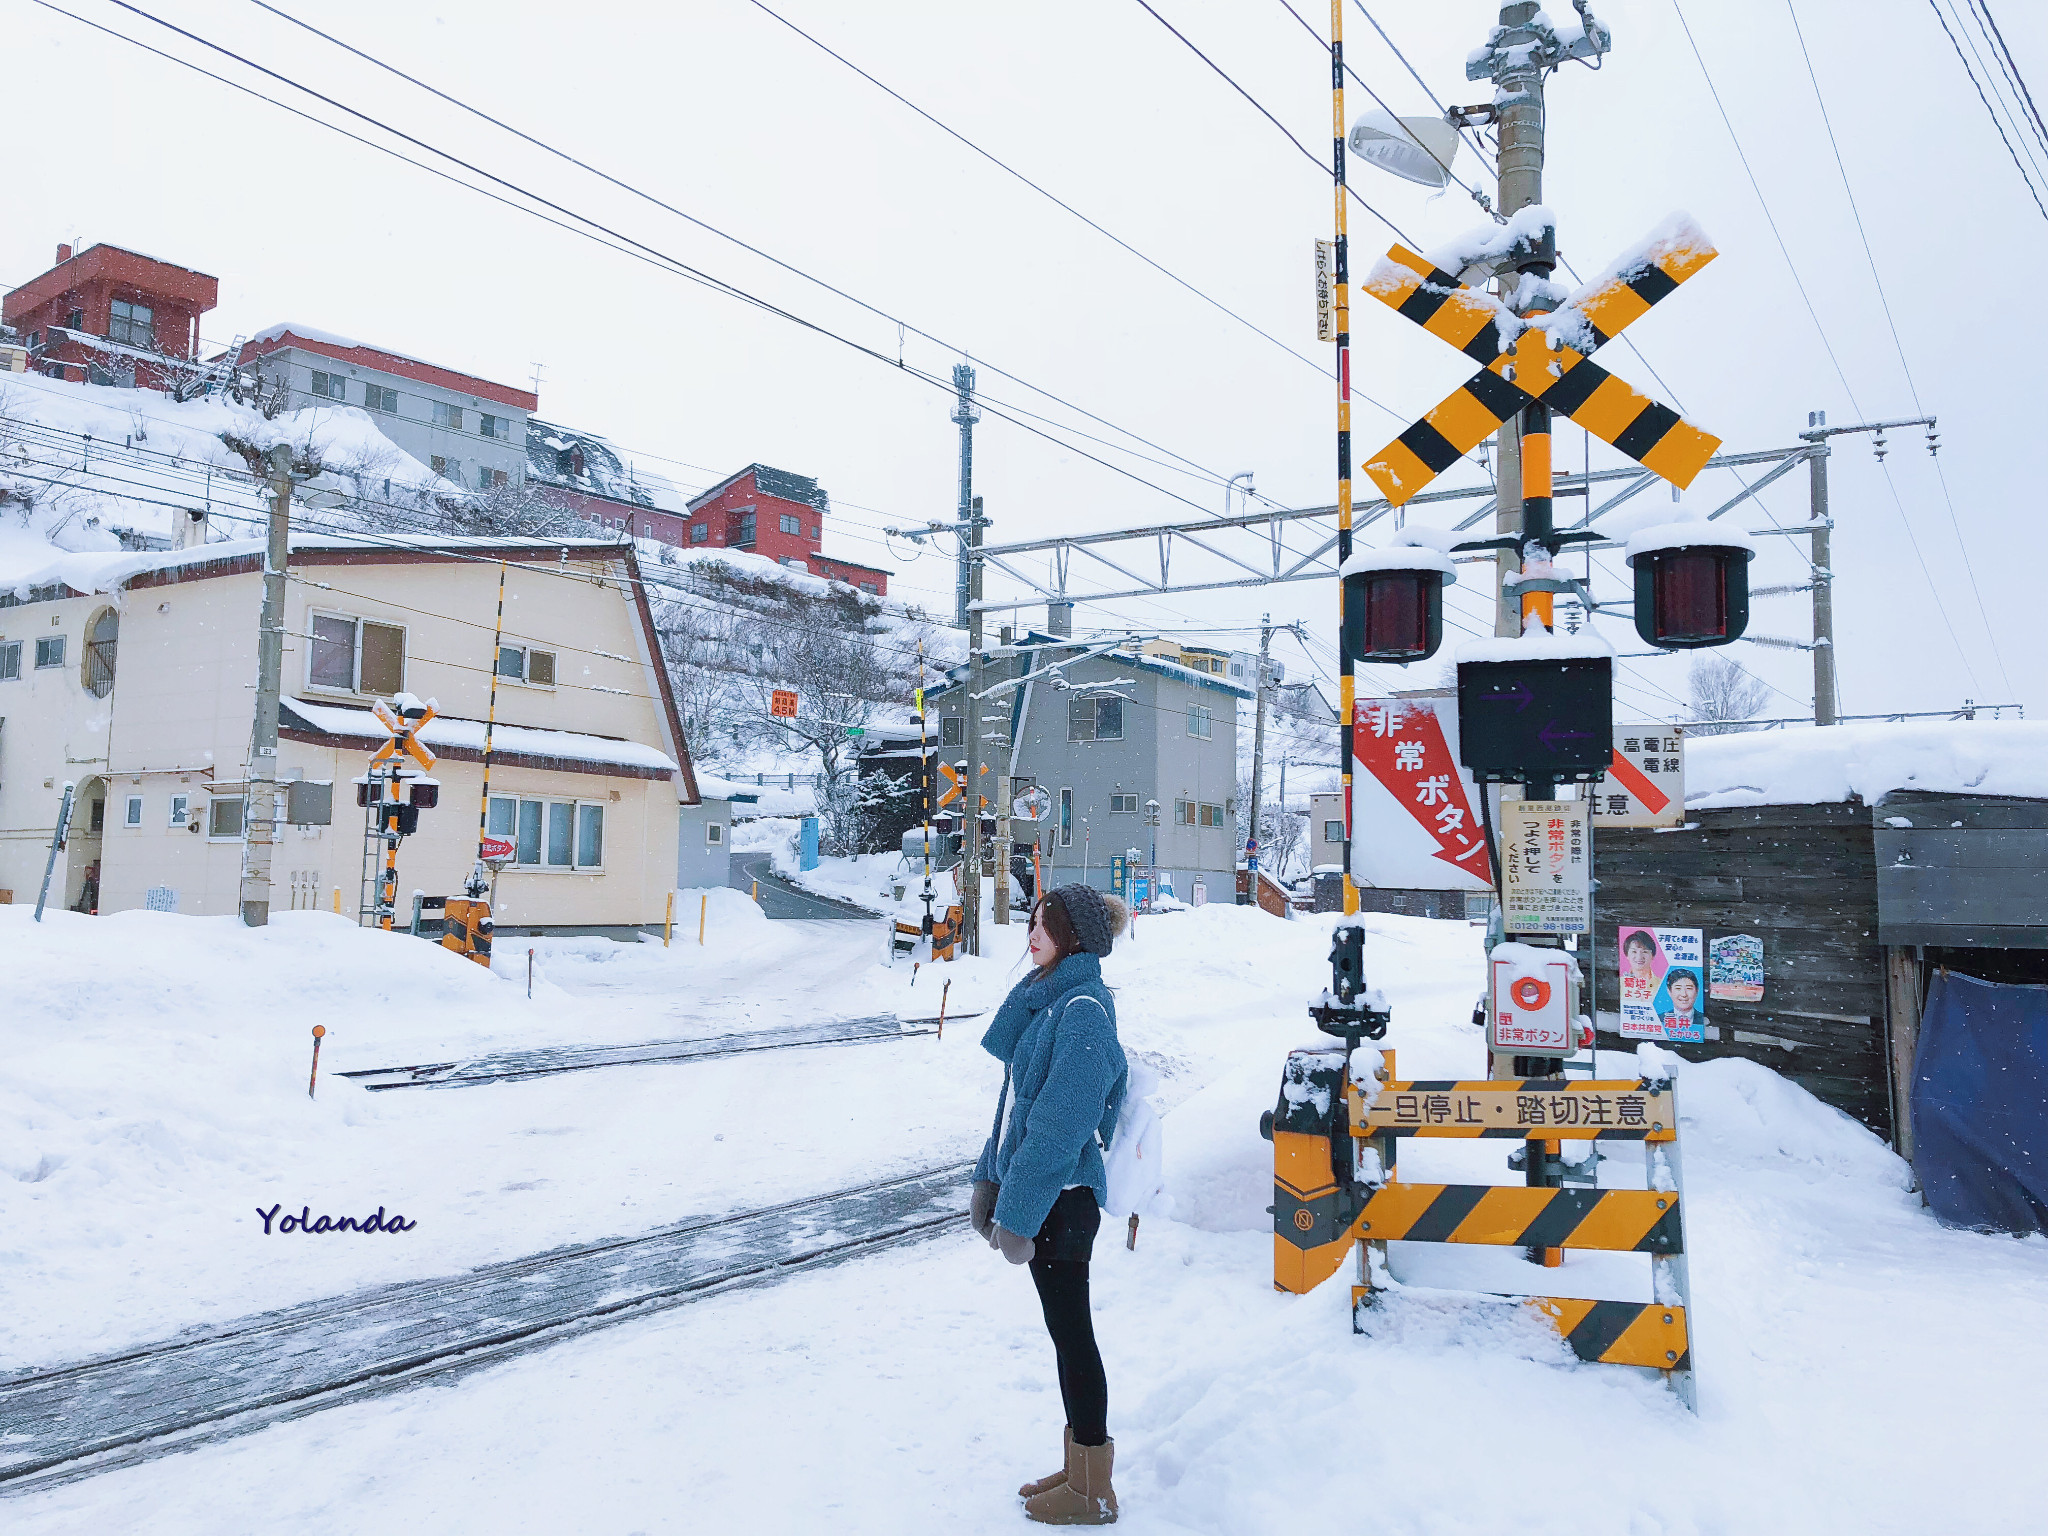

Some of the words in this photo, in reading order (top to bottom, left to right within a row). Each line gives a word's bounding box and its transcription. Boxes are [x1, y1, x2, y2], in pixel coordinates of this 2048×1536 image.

[1623, 737, 1680, 753] 高電圧
[1643, 757, 1680, 773] 電線
[1371, 707, 1485, 861] 非常ボタン
[1523, 820, 1541, 874] つよく押して
[1547, 818, 1565, 884] 非常ボタンを
[1570, 819, 1582, 864] 非常の際は
[1508, 842, 1520, 884] ください
[1499, 1028, 1564, 1043] 非常ボタン
[1622, 1023, 1662, 1033] 日本共産党
